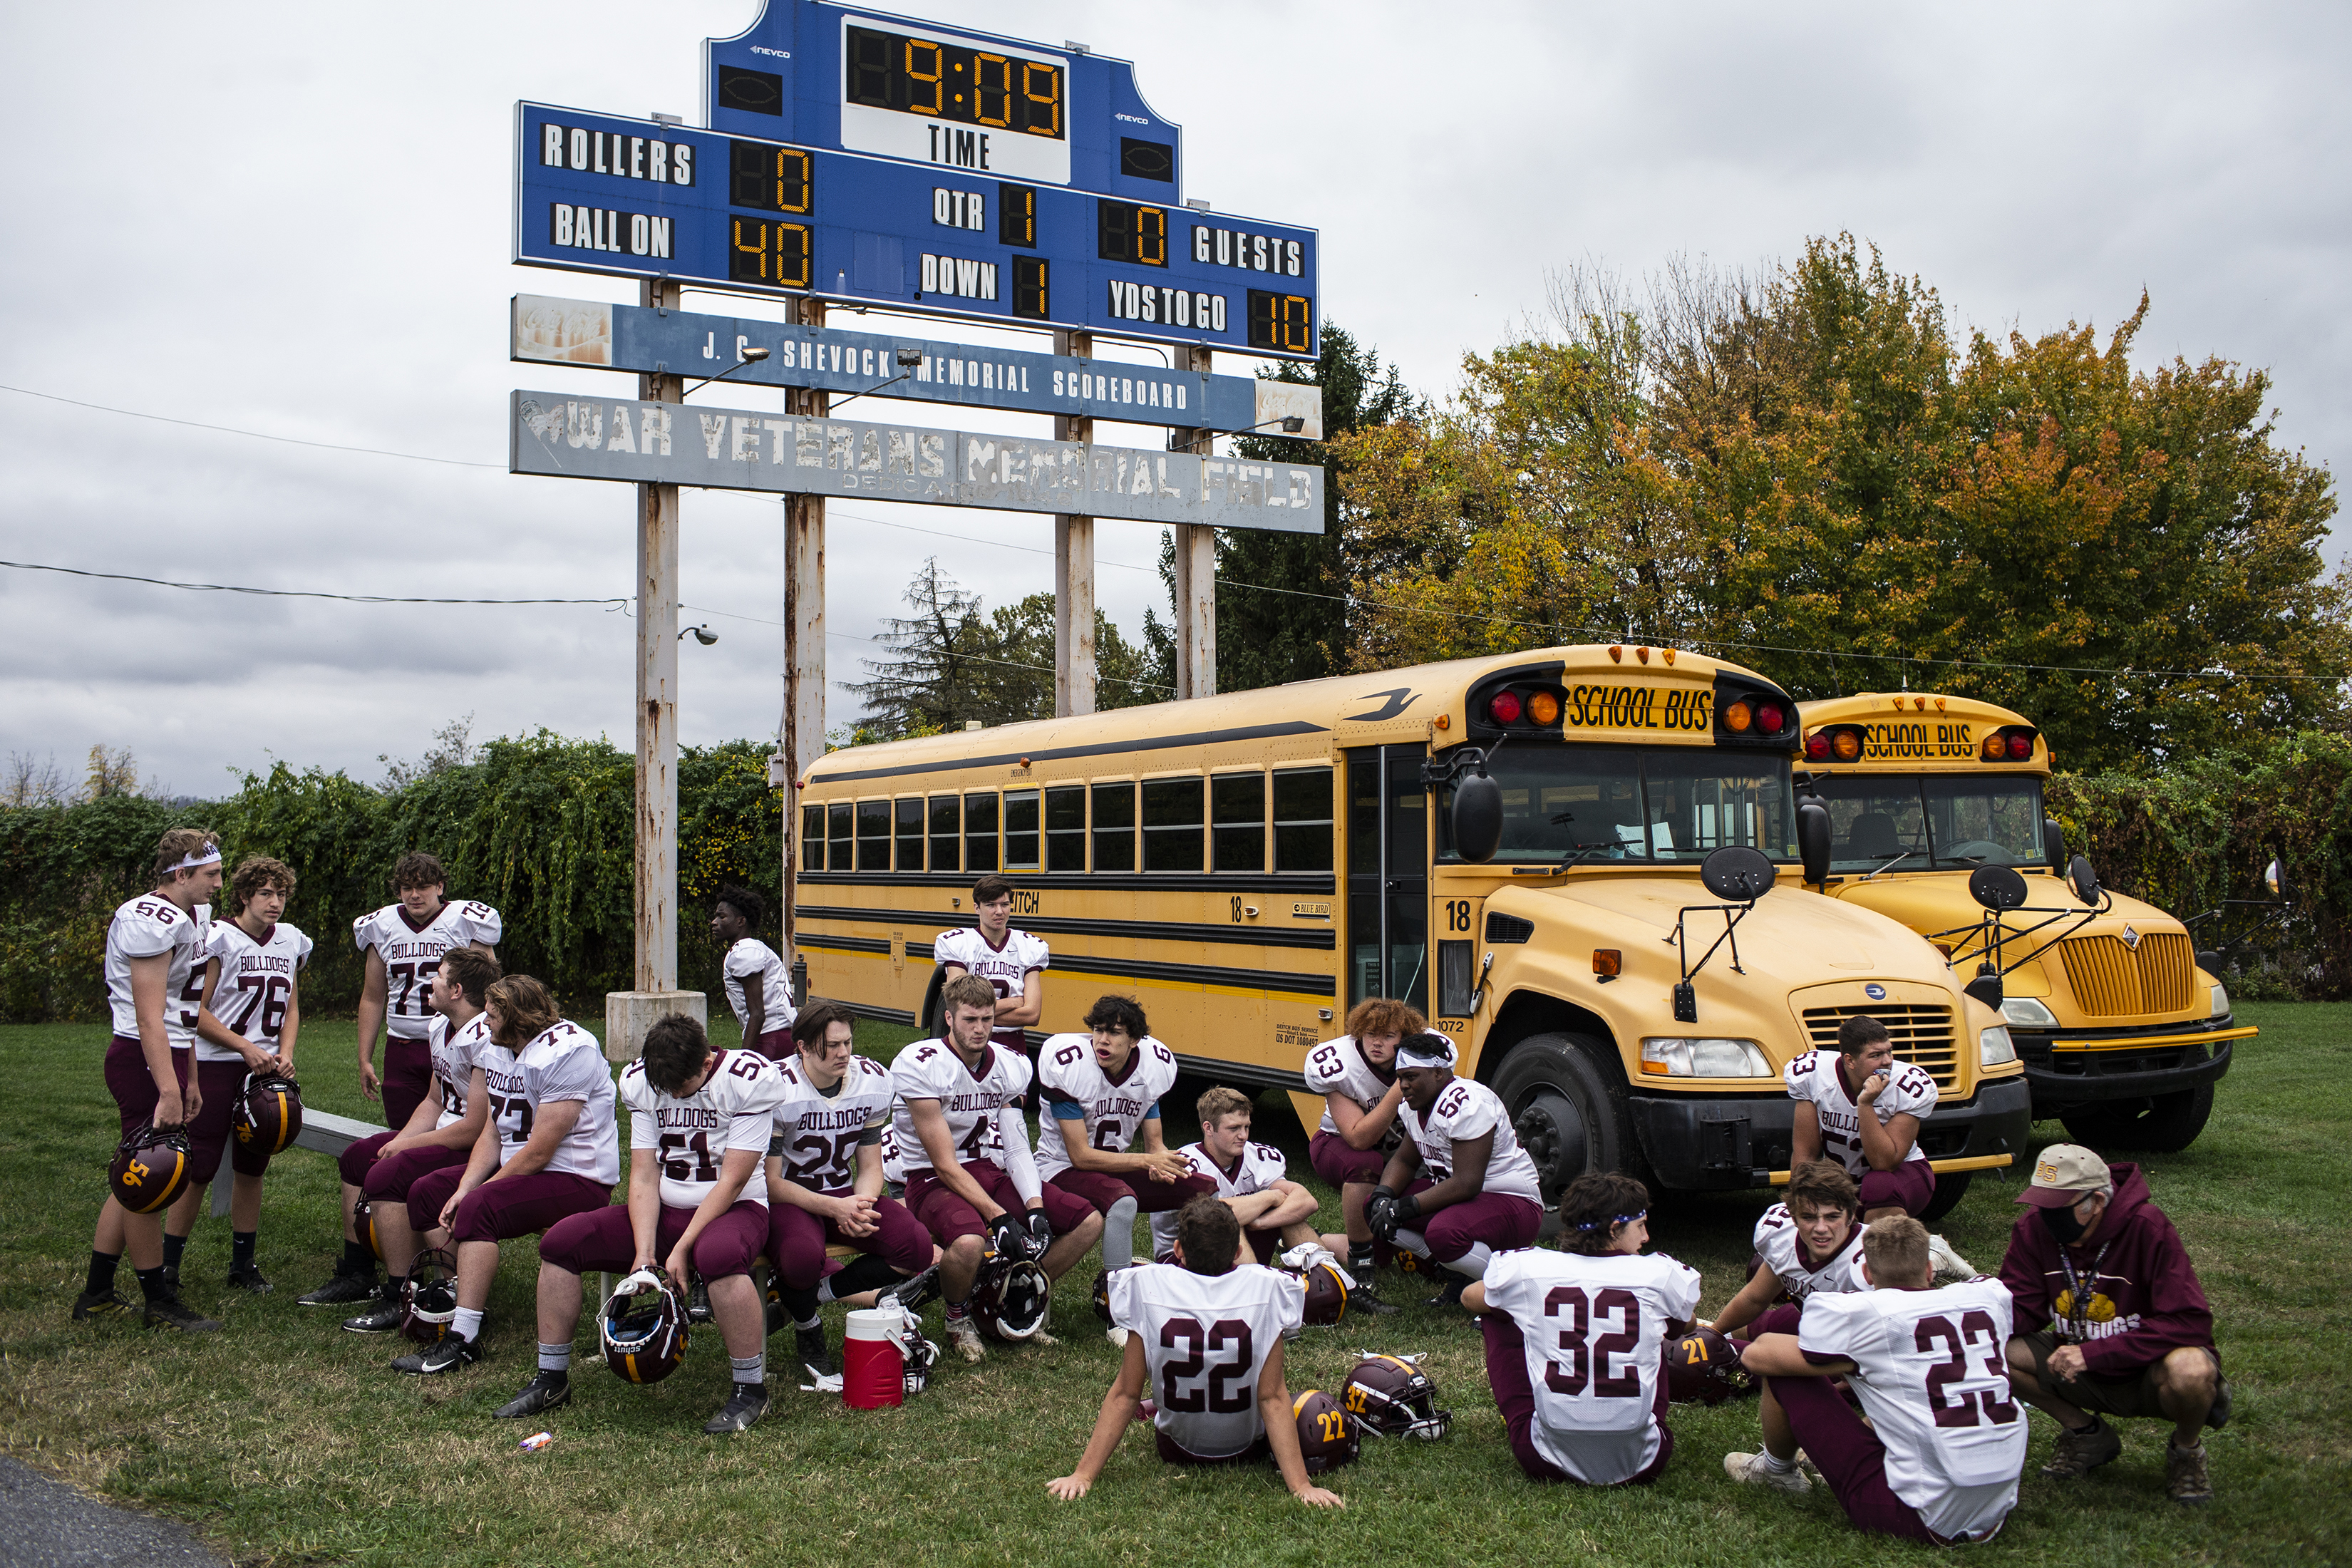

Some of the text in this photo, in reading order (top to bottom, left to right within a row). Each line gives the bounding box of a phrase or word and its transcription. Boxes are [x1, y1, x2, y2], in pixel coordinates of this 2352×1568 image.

[757, 46, 790, 58] NEVCO
[905, 38, 1058, 135] 9:09
[1120, 113, 1149, 125] NEVCO
[545, 123, 691, 185] ROLLERS
[928, 123, 989, 170] TIME
[778, 148, 808, 212] 0
[934, 188, 984, 231] QTR
[555, 203, 669, 258] BALL ON
[1138, 207, 1164, 264] 0
[735, 220, 808, 287] 40
[1196, 226, 1300, 277] GUESTS
[922, 254, 996, 300] DOWN
[1110, 280, 1226, 332] YDS TO GO
[1271, 296, 1309, 352] 10
[703, 331, 721, 360] J.
[784, 340, 890, 378] SHEVOCK
[917, 356, 1030, 393] MEMORIAL
[1053, 371, 1187, 410] SCOREBOARD
[567, 401, 1312, 510] WAR VETERANS MEMORIAL FIELD
[1570, 685, 1712, 731] SCHOOL BUS
[1866, 723, 1974, 758] SCHOOL BUS
[1011, 768, 1026, 777] EMERGENCY
[135, 902, 178, 925] 56
[461, 901, 491, 921] 72
[1230, 895, 1242, 923] 18
[1301, 904, 1329, 914] BLUE BIRD
[1445, 899, 1471, 932] 18
[240, 955, 289, 974] BULLDOGS
[391, 942, 447, 959] BULLDOGS
[974, 960, 1020, 979] BULLDOGS
[230, 975, 291, 1037] 76
[537, 1023, 578, 1048] 77
[1276, 1033, 1319, 1047] US DOT 1080497
[1437, 1020, 1464, 1032] 1072
[915, 1046, 938, 1063] 4
[1056, 1045, 1083, 1066] 6
[1312, 1046, 1344, 1079] 63
[1896, 1066, 1931, 1098] 53
[797, 1105, 872, 1131] BULLDOGS
[951, 1092, 1002, 1112] BULLDOGS
[1093, 1098, 1142, 1118] BULLDOGS
[1437, 1085, 1470, 1120] 52
[237, 1122, 254, 1143] 76
[655, 1108, 718, 1129] BULLDOGS
[1822, 1110, 1860, 1133] BULLD
[123, 1158, 150, 1187] 56
[658, 1132, 718, 1182] 51
[784, 1129, 864, 1191] 25
[2036, 1160, 2058, 1183] BS
[614, 1346, 641, 1354] schutt
[1544, 1286, 1641, 1398] 32
[1681, 1337, 1709, 1365] 21
[1160, 1317, 1252, 1413] 22
[1914, 1310, 2018, 1428] 23
[1346, 1385, 1368, 1413] 32
[1316, 1410, 1346, 1443] 22
